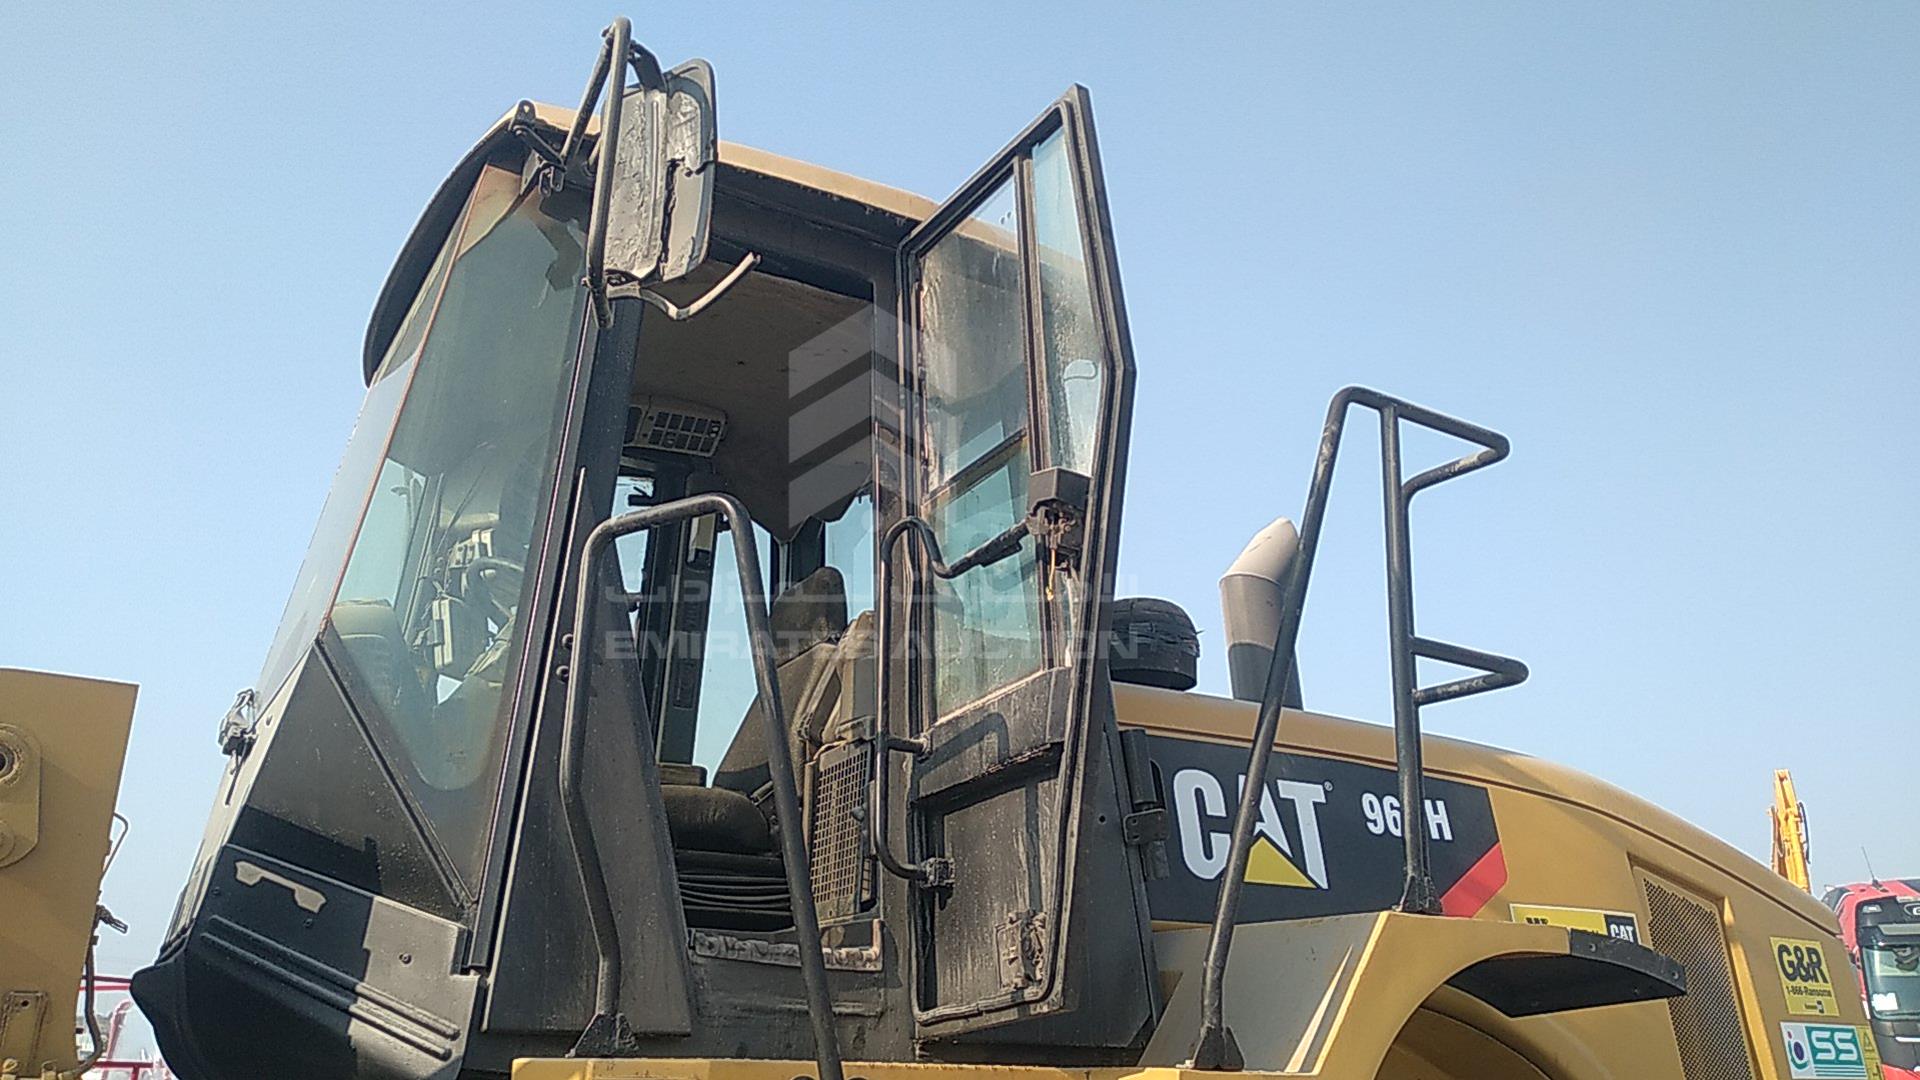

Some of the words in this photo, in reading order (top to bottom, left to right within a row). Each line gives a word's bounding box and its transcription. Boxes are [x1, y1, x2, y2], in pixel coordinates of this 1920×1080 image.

[1360, 792, 1454, 842] 96H
[1609, 923, 1635, 943] CAT
[1777, 943, 1829, 984] G&R
